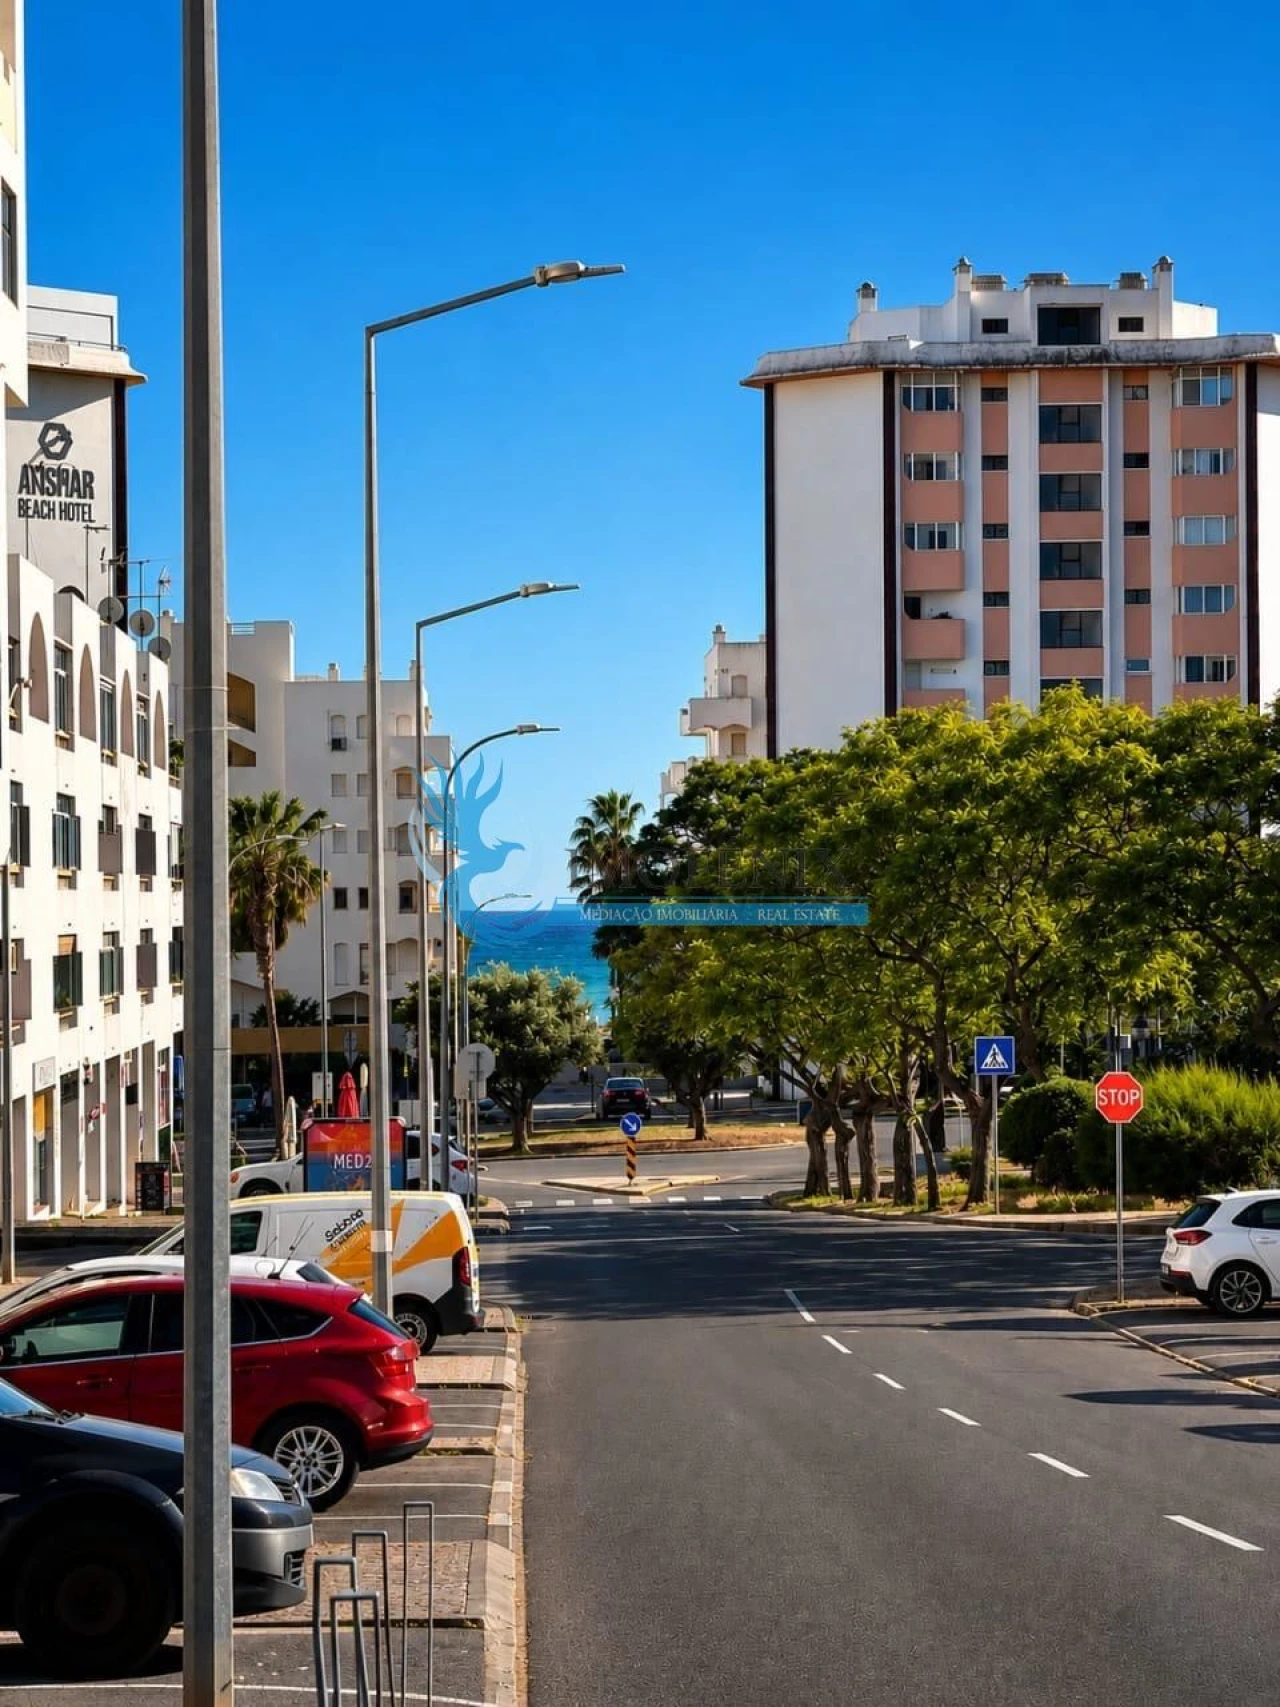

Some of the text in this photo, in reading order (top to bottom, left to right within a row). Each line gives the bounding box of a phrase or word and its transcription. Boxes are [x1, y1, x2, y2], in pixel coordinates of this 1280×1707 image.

[18, 463, 94, 499] ANSHAR
[18, 498, 96, 522] BEACH HOTEL
[1098, 1088, 1140, 1106] STOP
